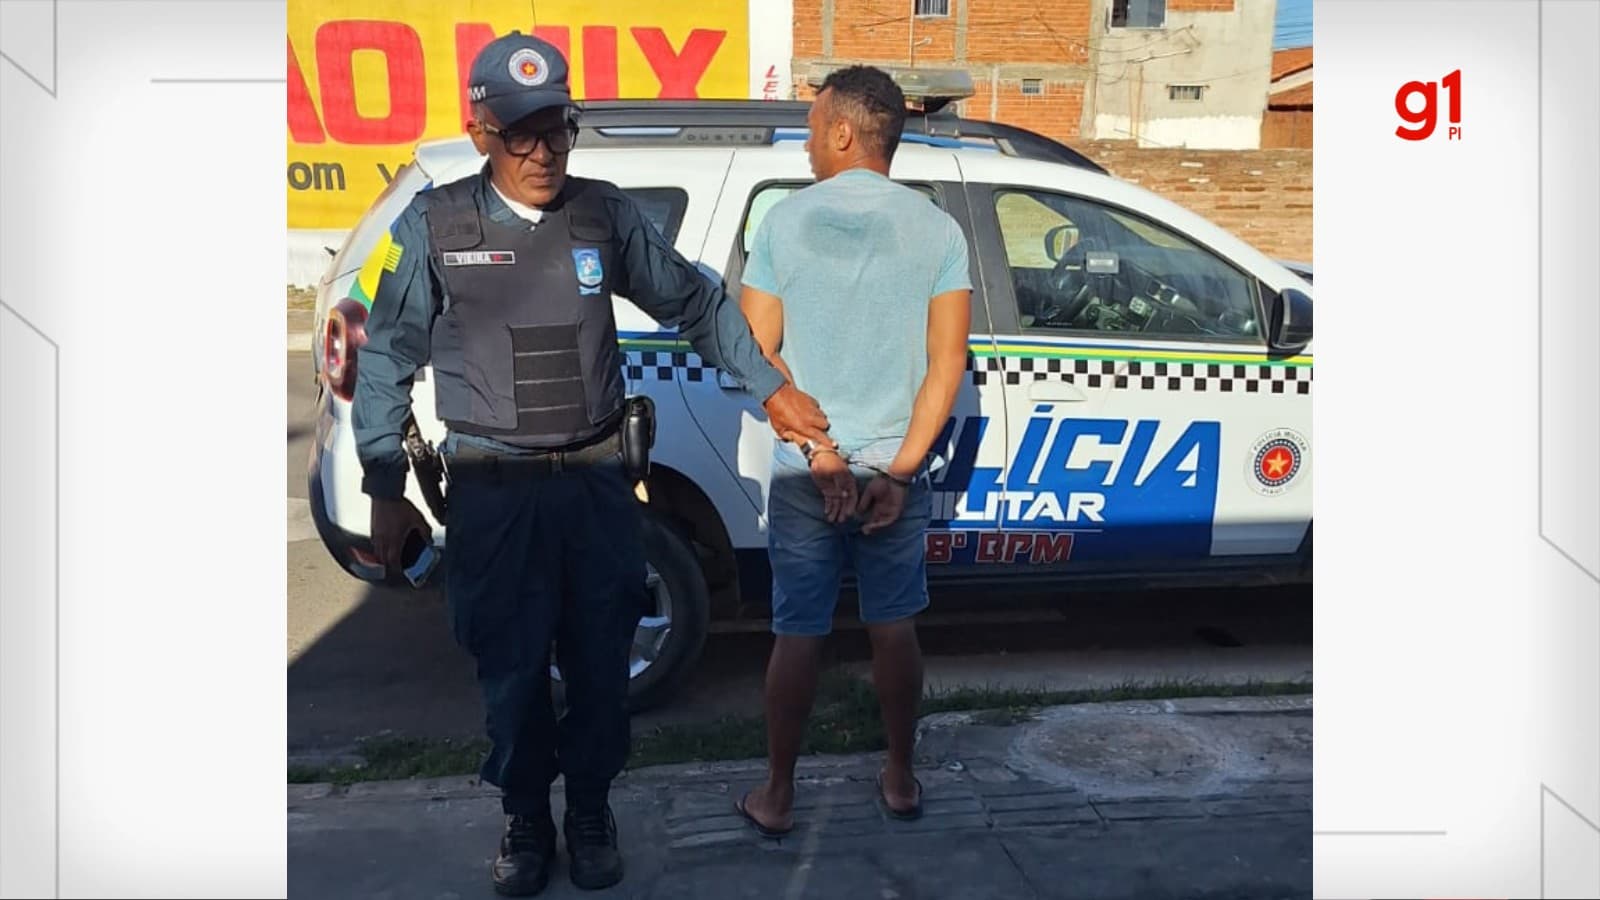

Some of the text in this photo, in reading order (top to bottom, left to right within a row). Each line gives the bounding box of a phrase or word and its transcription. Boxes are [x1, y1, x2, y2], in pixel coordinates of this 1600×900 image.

[687, 133, 762, 142] DUSTER
[922, 404, 1221, 492] LÍCIA
[975, 532, 1074, 564] BPM
